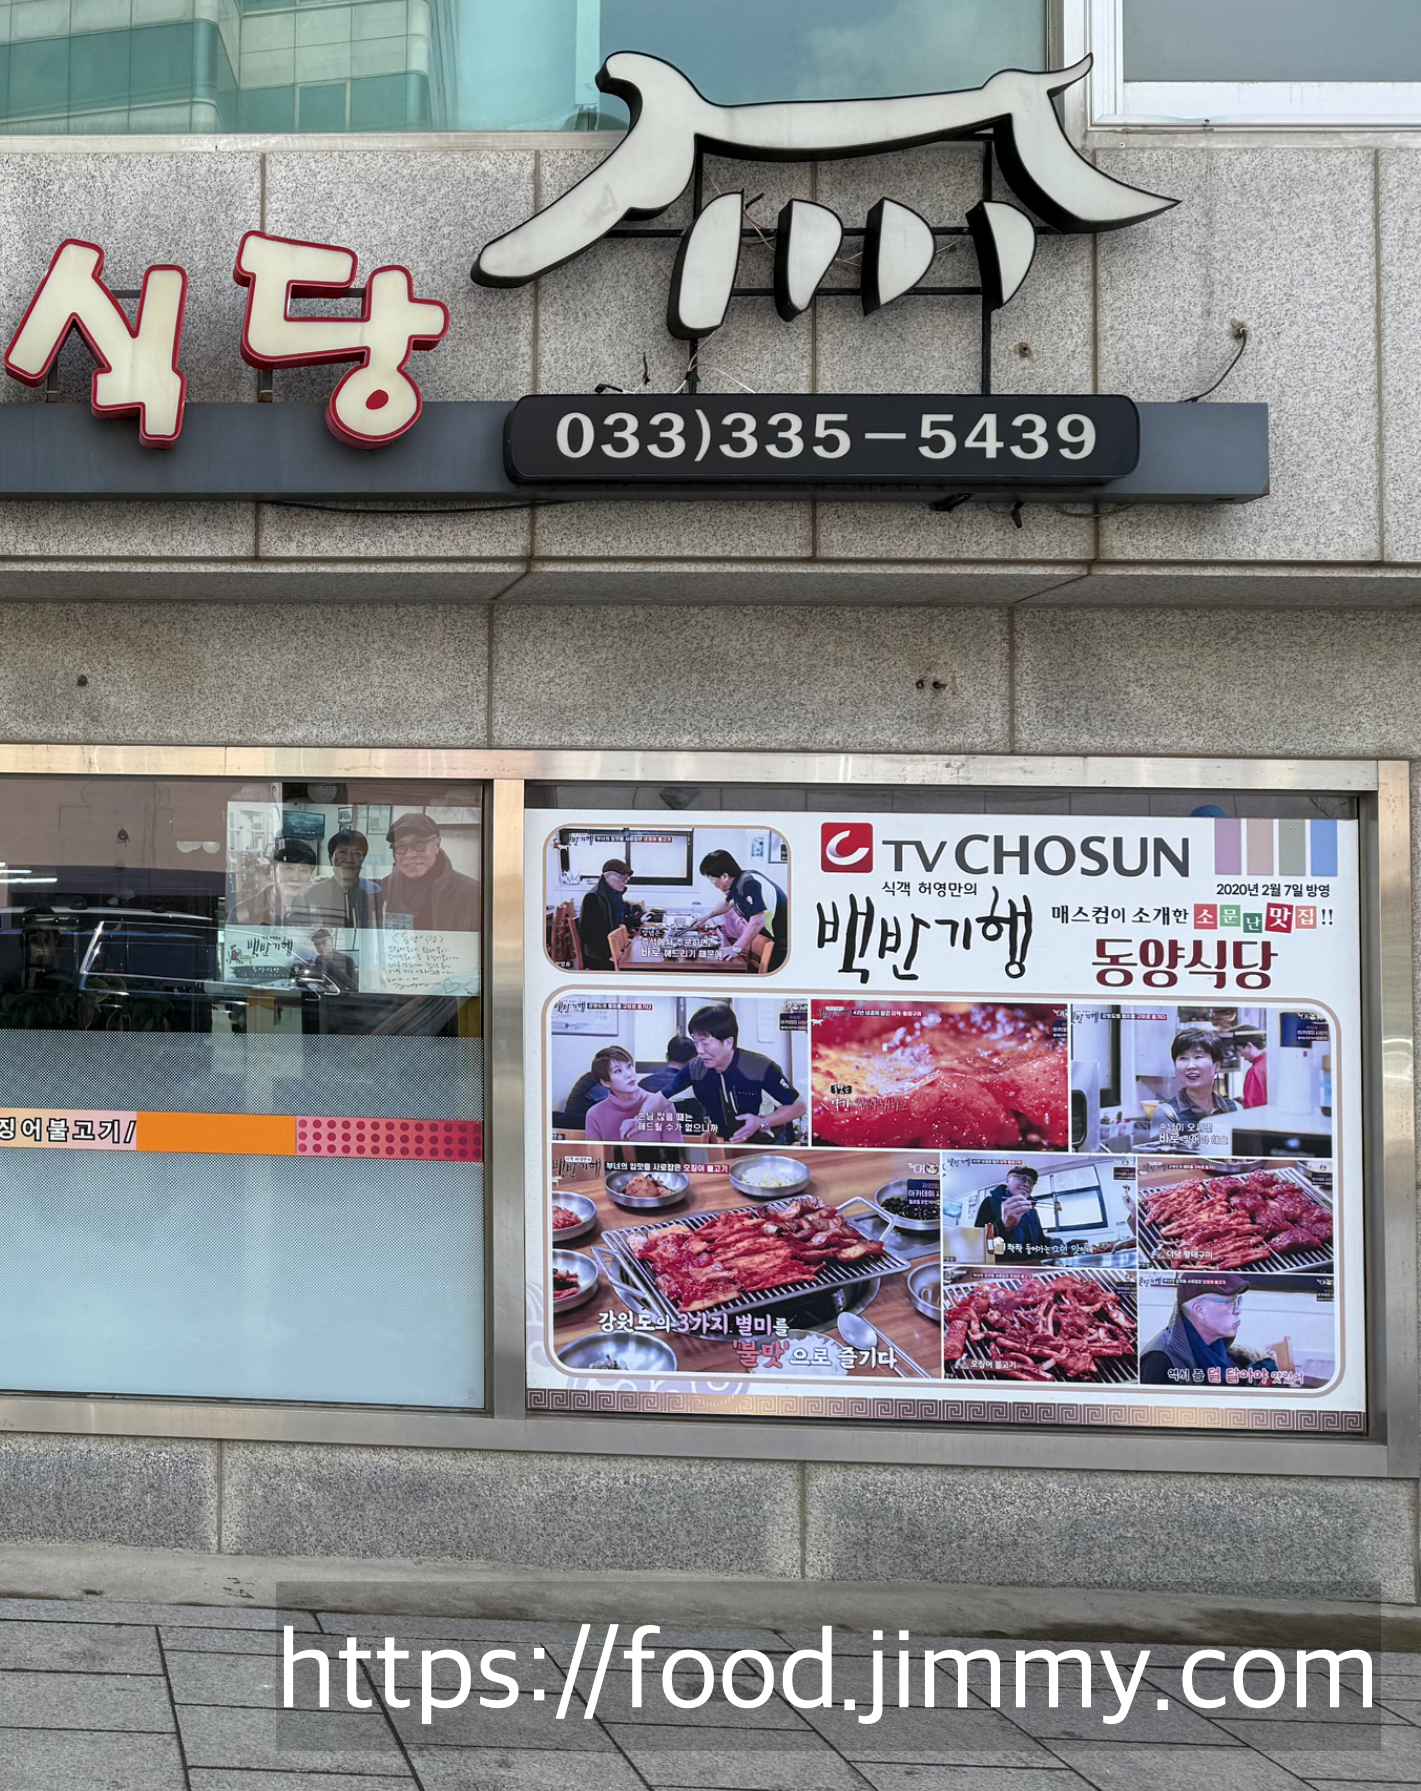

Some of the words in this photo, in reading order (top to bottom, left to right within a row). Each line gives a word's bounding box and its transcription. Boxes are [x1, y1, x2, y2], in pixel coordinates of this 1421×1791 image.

[882, 840, 947, 872] TV
[955, 833, 1189, 877] CHOSUN
[881, 880, 911, 897] 식객
[918, 881, 978, 897] 허영만의
[1216, 883, 1259, 897] 2020년
[1262, 883, 1281, 897] 2월
[1284, 884, 1303, 897] 7일
[1306, 884, 1330, 898] 방영
[1051, 905, 1126, 925] 매스컴이
[1131, 906, 1189, 926] 소개한
[816, 886, 1033, 984] 백반기행
[641, 948, 661, 957] 바로
[664, 949, 696, 958] 해드리기
[699, 950, 723, 959] 때문에
[1092, 938, 1278, 990] 동양식당
[666, 1123, 682, 1132] 수가
[685, 1123, 718, 1133] 없으니까
[606, 1162, 627, 1170] 부녀의
[630, 1162, 650, 1171] 입맛을
[653, 1163, 681, 1171] 사로잡은
[683, 1164, 705, 1172] 오징어
[598, 1310, 671, 1334] 강원도의
[678, 1312, 729, 1335] 3가지
[736, 1314, 791, 1337] 별미를
[838, 1347, 898, 1369] 즐기다
[970, 1360, 993, 1370] 오징어
[1167, 1368, 1190, 1382] 역시
